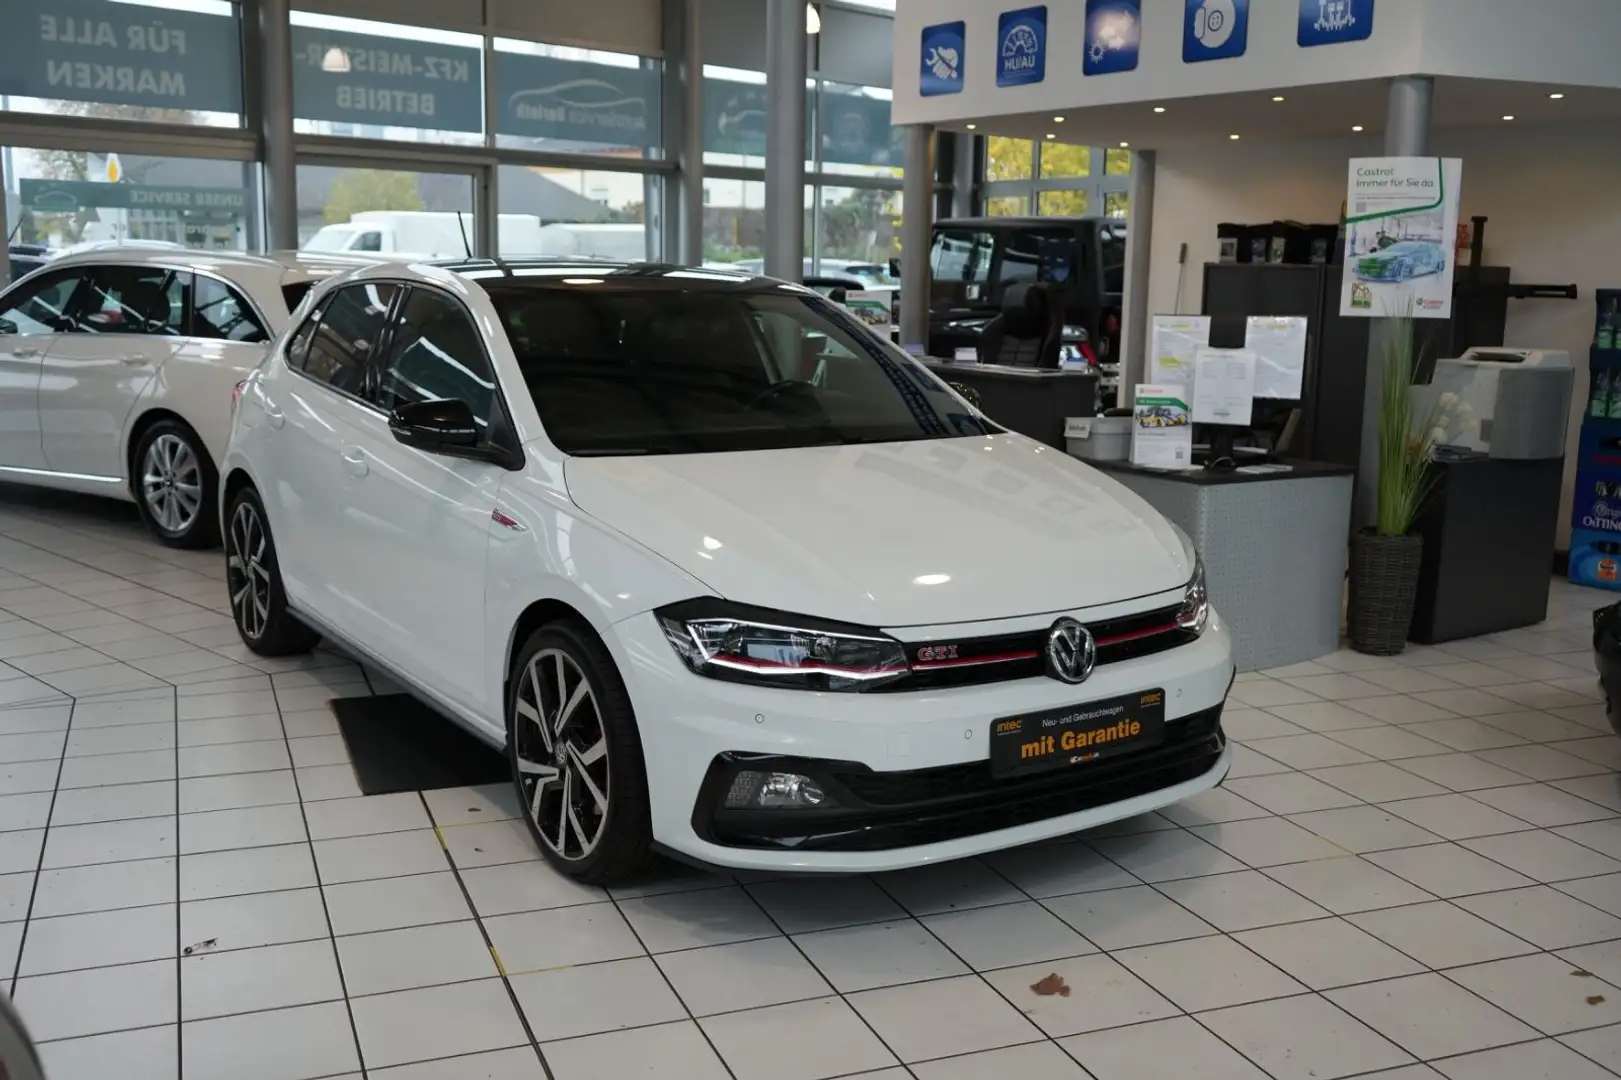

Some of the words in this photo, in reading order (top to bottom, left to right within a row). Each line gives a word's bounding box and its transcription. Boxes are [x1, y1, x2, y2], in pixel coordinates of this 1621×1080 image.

[1356, 178, 1388, 188] Immer
[1390, 178, 1403, 187] für
[1406, 177, 1419, 187] Sie
[917, 645, 958, 661] GTI
[1042, 719, 1059, 729] Neu-
[1060, 715, 1073, 724] und
[1073, 705, 1124, 722] Gebrauchtwagen
[1021, 734, 1055, 759] mit
[1061, 719, 1141, 750] Garantie
